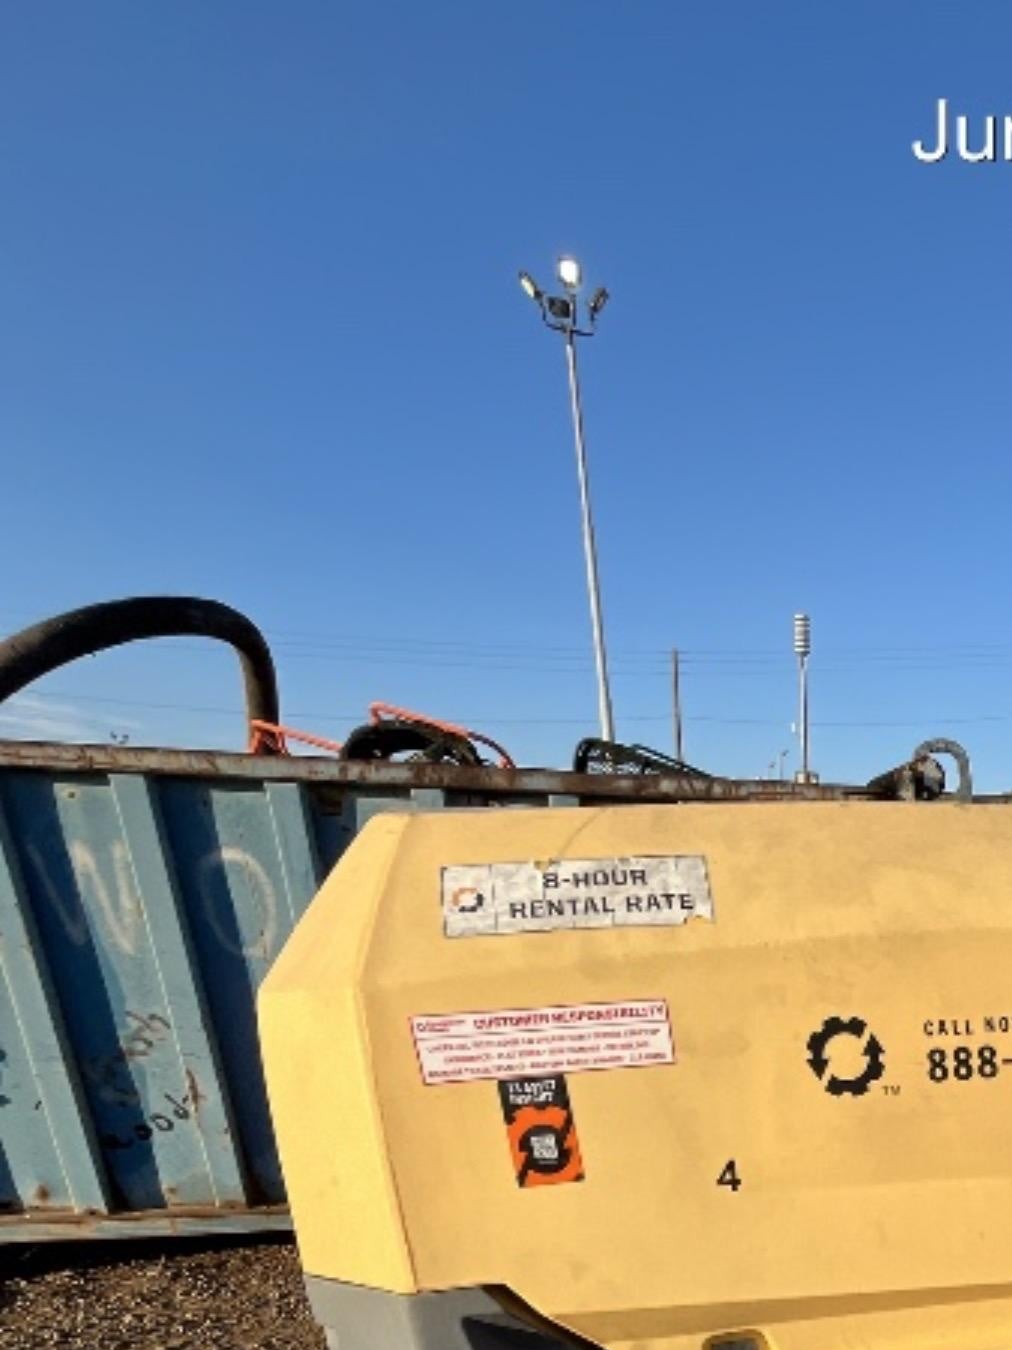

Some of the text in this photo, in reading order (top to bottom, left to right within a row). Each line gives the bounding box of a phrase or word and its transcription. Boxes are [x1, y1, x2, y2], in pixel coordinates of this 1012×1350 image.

[542, 868, 649, 889] 8-HOUR
[509, 893, 696, 920] RENTAL RATE
[923, 1019, 974, 1036] CALL
[716, 1158, 743, 1192] 4
